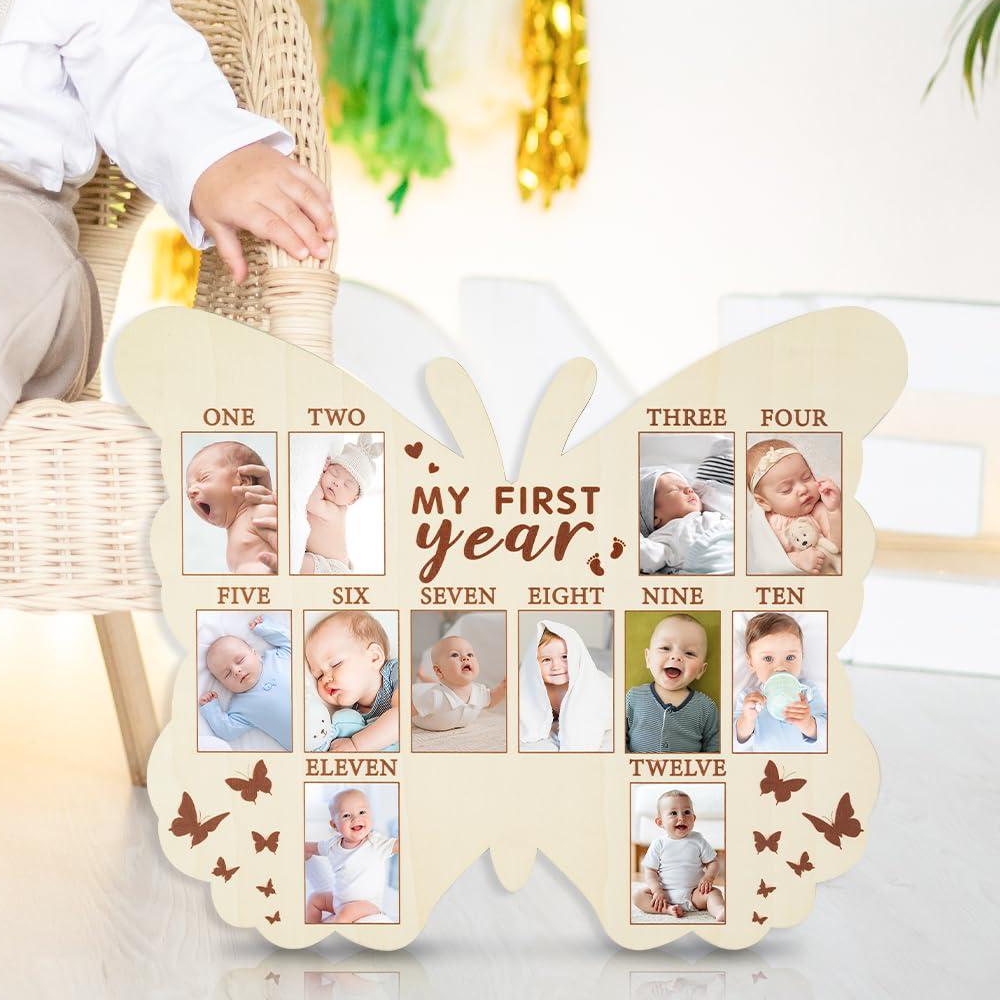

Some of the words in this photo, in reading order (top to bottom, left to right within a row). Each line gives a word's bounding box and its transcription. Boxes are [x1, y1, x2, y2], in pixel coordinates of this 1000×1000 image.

[203, 407, 255, 427] ONE
[308, 407, 365, 427] TWO
[647, 407, 727, 427] THREE
[761, 408, 828, 427] FOUR
[411, 486, 470, 515] MY
[495, 486, 601, 515] FIRST
[416, 518, 595, 584] year
[217, 586, 271, 605] FIVE
[332, 586, 370, 605] SIX
[420, 586, 496, 605] SEVEN
[528, 586, 604, 605] EIGHT
[642, 586, 704, 605] NINE
[756, 586, 805, 605] TEN
[306, 758, 398, 777] ELEVEN
[629, 758, 727, 777] TWELVE
